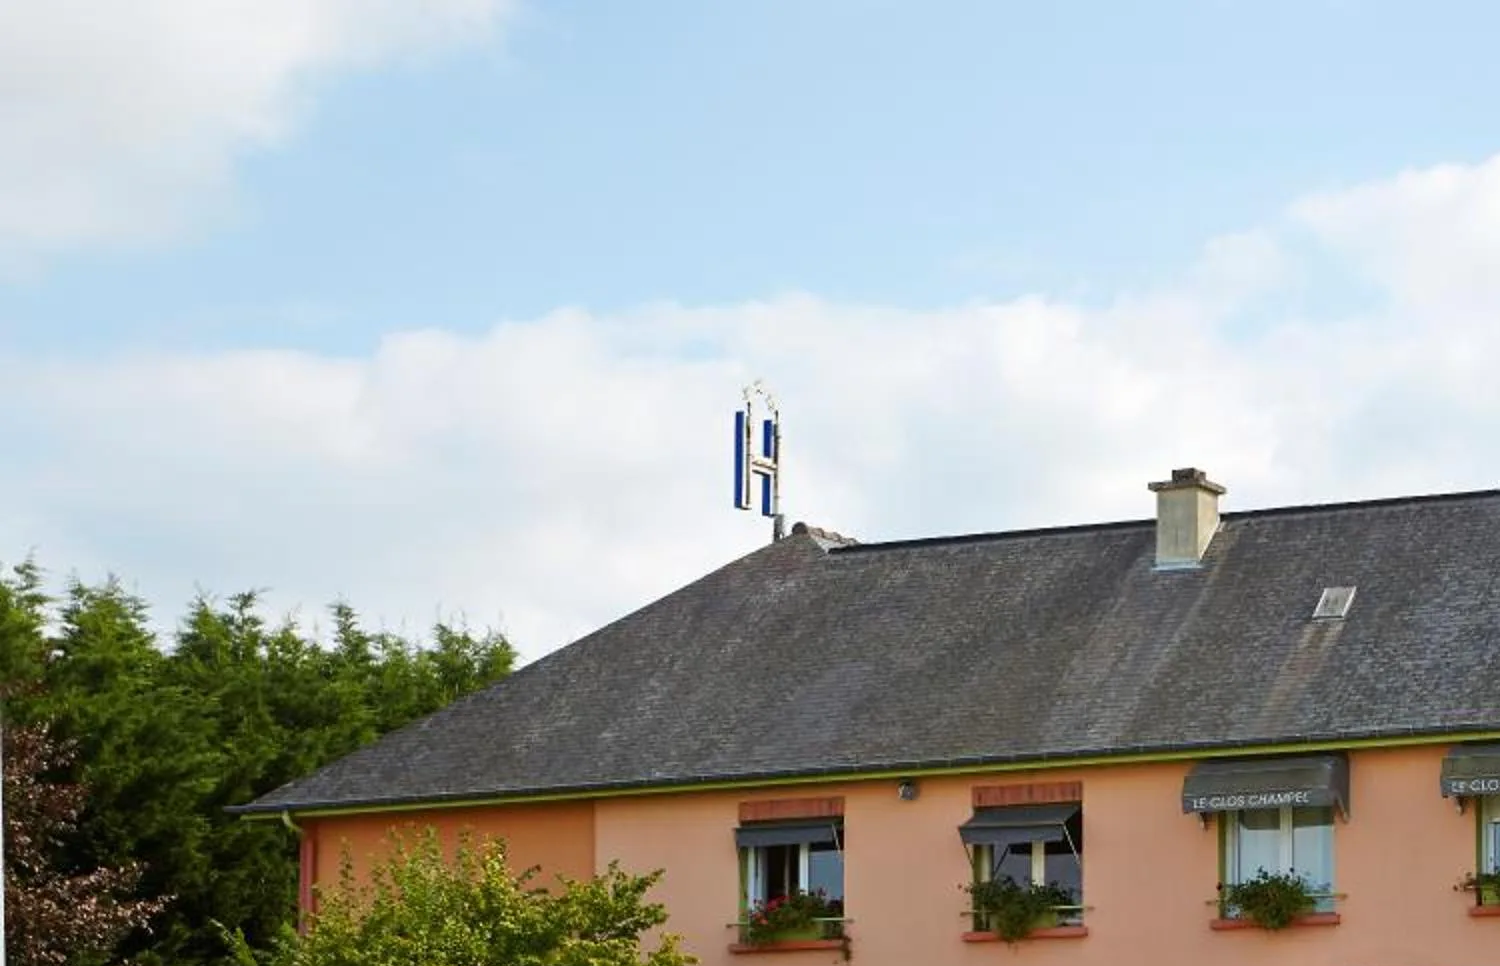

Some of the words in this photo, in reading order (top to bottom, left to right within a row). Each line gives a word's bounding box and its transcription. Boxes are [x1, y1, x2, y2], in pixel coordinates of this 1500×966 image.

[733, 399, 782, 519] H
[1451, 780, 1466, 793] LE
[1193, 796, 1207, 809] LE
[1209, 795, 1245, 809] CLOS
[1247, 790, 1313, 806] CHAMPEL
